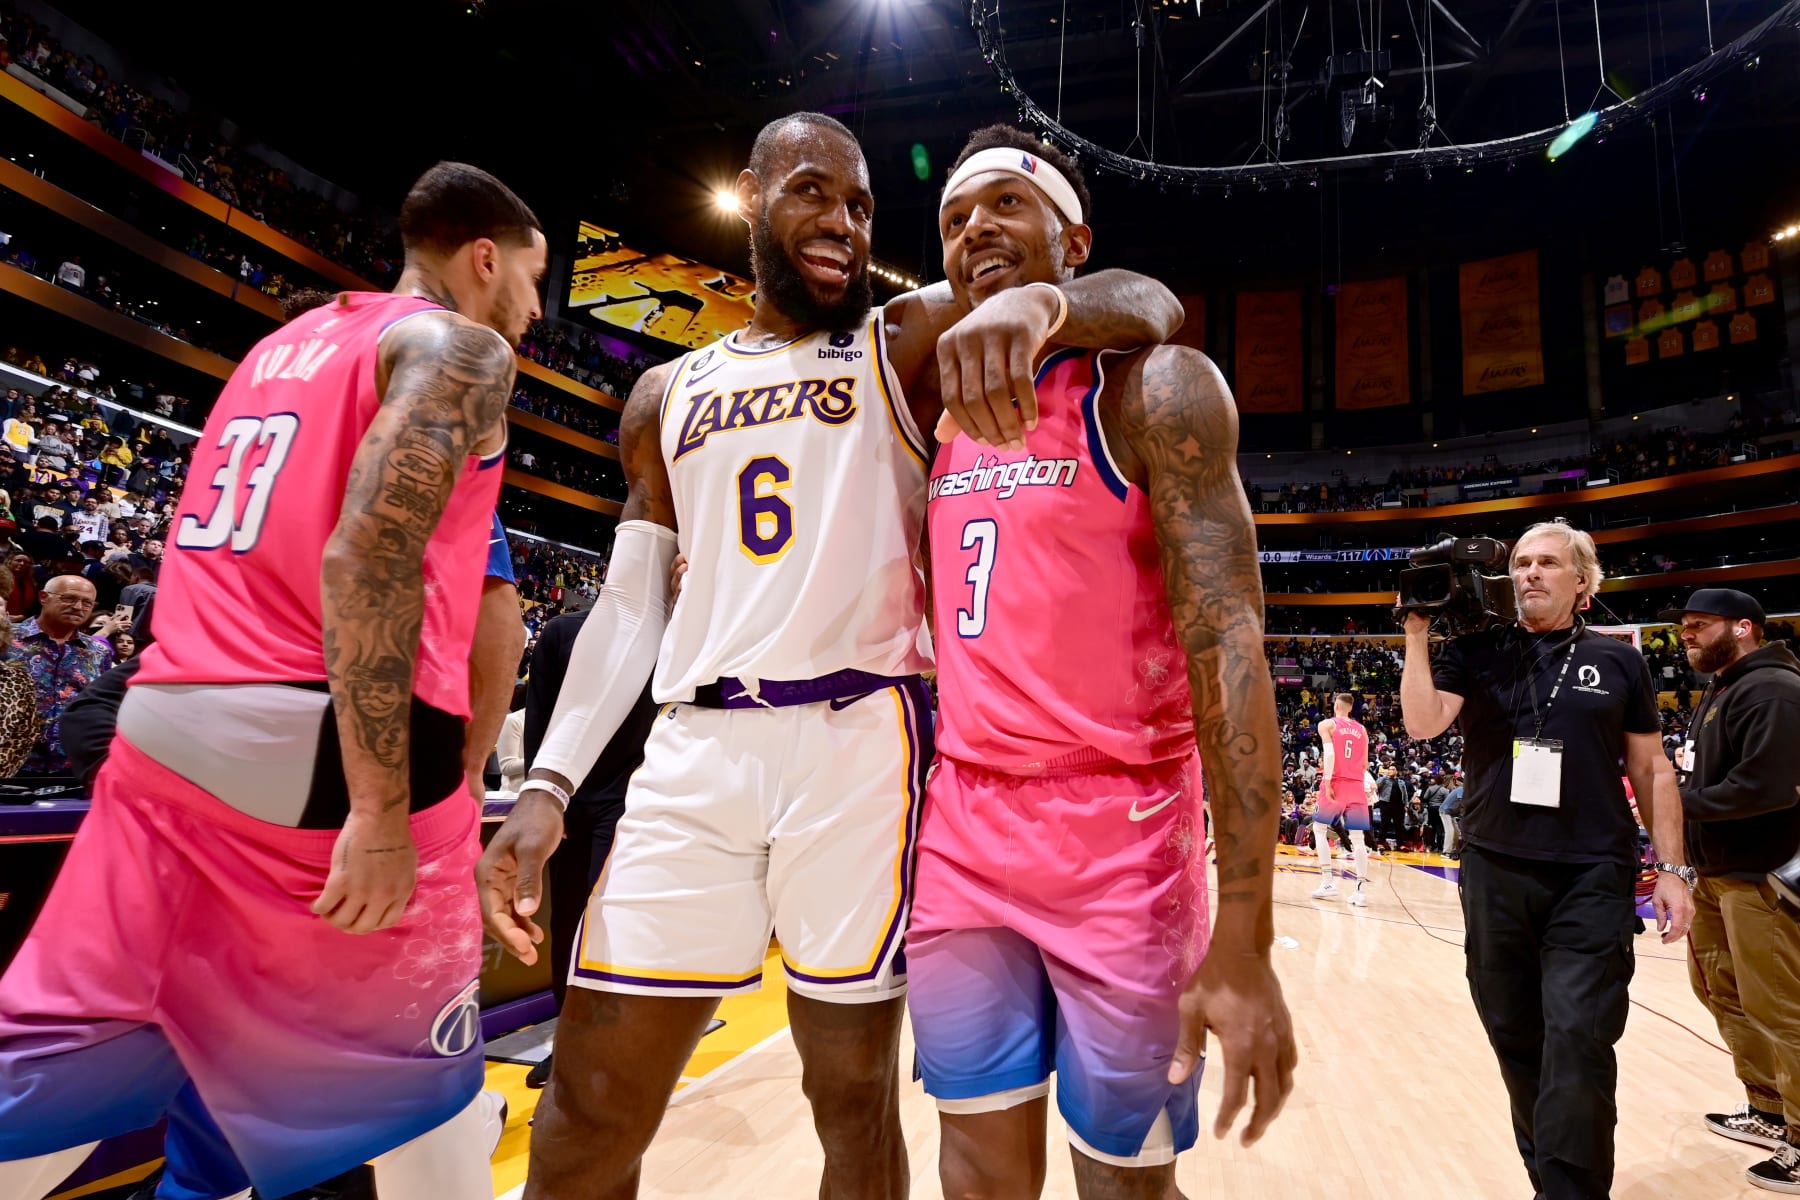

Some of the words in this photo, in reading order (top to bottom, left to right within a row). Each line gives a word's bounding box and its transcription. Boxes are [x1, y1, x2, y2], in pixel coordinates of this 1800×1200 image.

[817, 348, 863, 362] bibigo
[672, 376, 859, 466] LAKERS
[175, 411, 301, 554] 33
[736, 452, 796, 566] 6
[79, 525, 93, 534] 24
[1263, 553, 1281, 562] 0.0
[1341, 552, 1361, 561] 117
[956, 517, 999, 639] 3
[1344, 739, 1353, 759] 6
